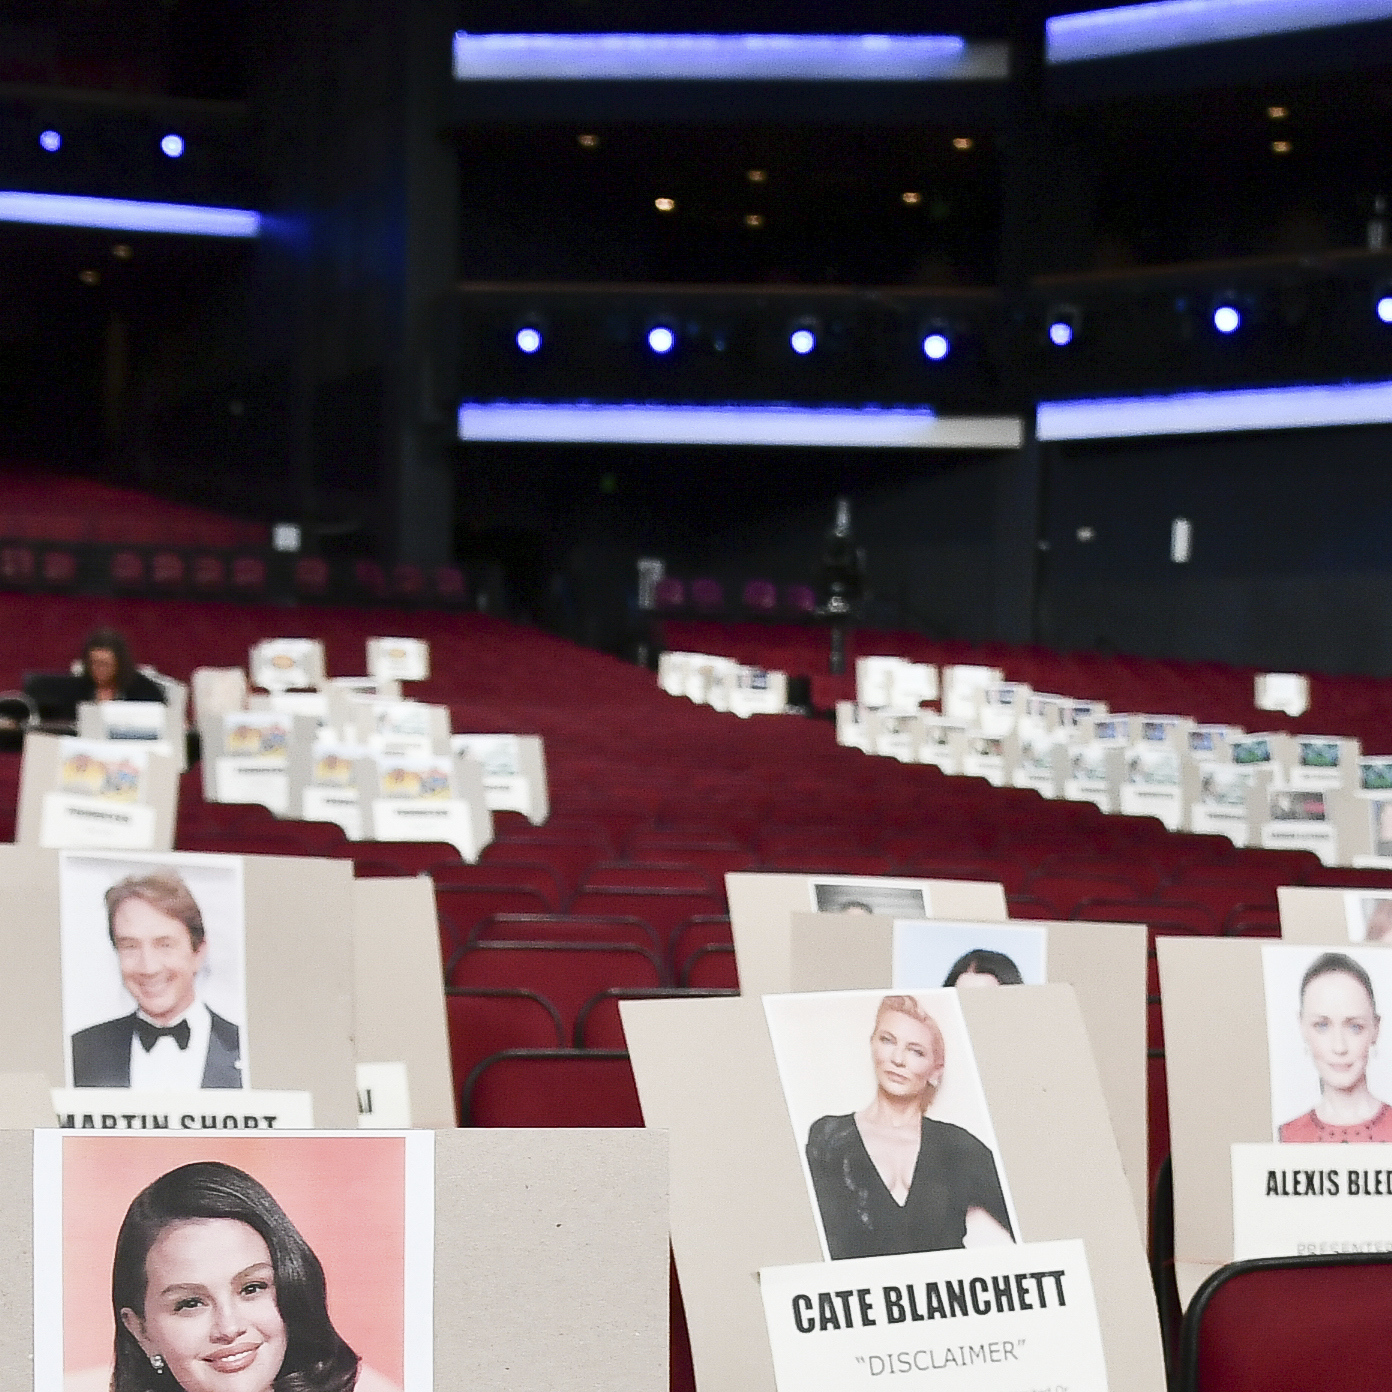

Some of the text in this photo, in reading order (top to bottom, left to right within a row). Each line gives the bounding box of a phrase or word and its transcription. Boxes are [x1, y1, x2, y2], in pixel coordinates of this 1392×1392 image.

[1266, 1170, 1339, 1196] ALEXIS
[793, 1270, 1066, 1333] CATE BLANCHETT
[855, 1339, 1026, 1376] “DISCLAIMER”
